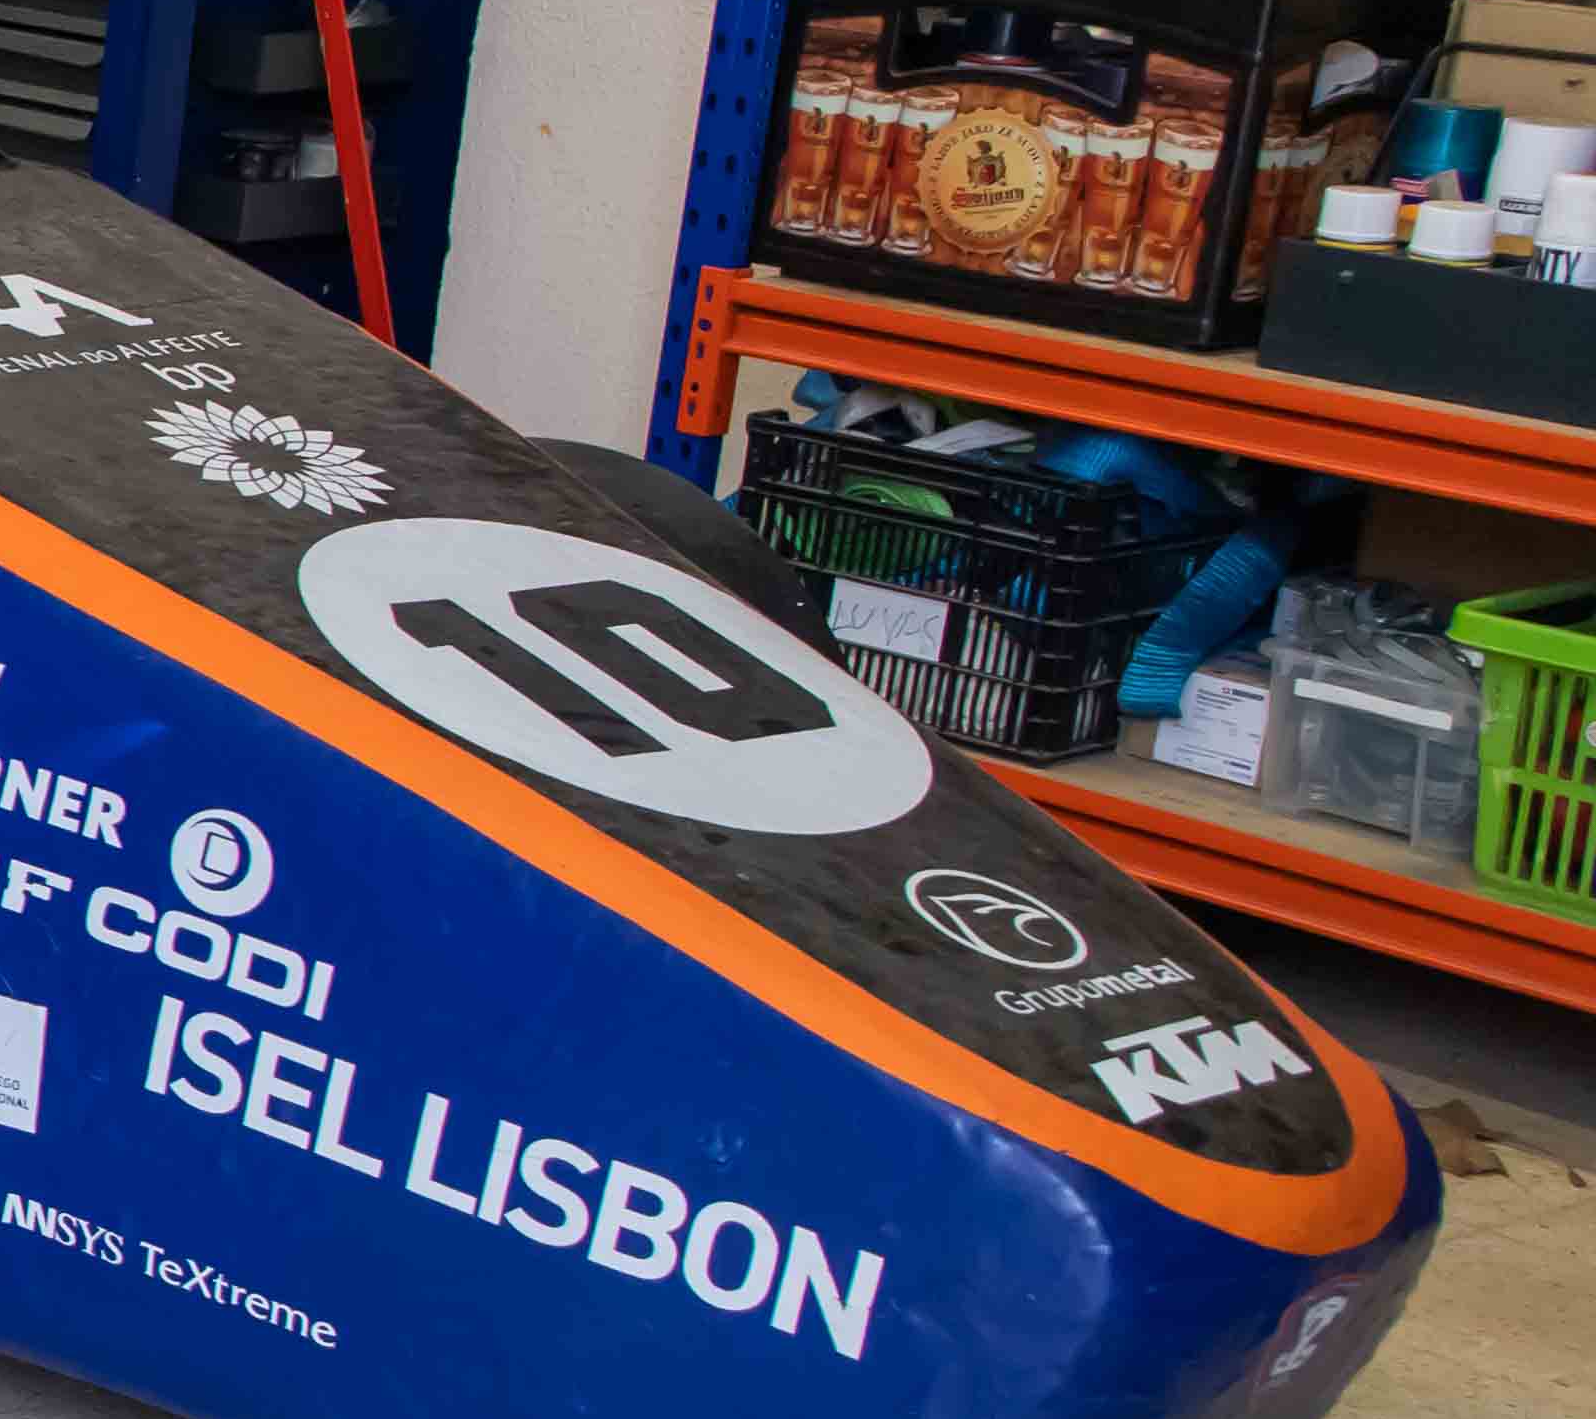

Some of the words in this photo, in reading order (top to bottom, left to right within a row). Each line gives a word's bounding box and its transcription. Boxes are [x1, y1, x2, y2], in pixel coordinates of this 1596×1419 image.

[83, 345, 111, 366] DO
[113, 328, 242, 366] ALFEITE
[141, 355, 239, 395] bp
[389, 578, 838, 760] 10
[86, 885, 335, 1022] CODI
[993, 956, 1192, 1018] Grupometal
[1089, 1013, 1313, 1125] KTM
[144, 994, 384, 1180] ISEL
[404, 1091, 886, 1362] LISBON
[1, 1192, 125, 1267] ANSYS
[139, 1239, 340, 1352] TeXtreme
